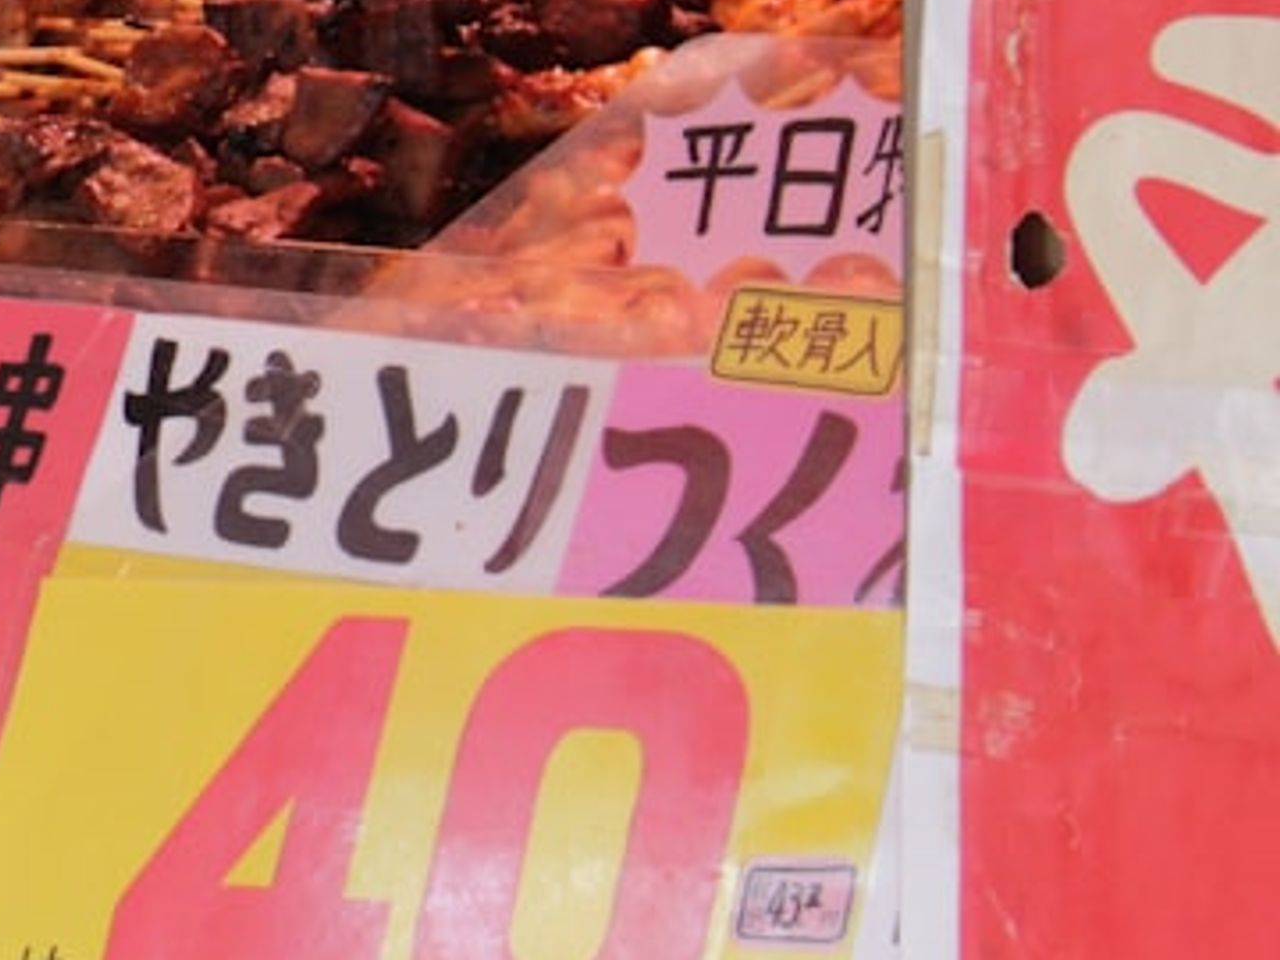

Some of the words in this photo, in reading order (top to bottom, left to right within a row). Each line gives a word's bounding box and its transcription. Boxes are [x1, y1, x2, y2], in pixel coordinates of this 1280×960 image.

[123, 337, 591, 575] やきとり
[101, 613, 752, 960] 40
